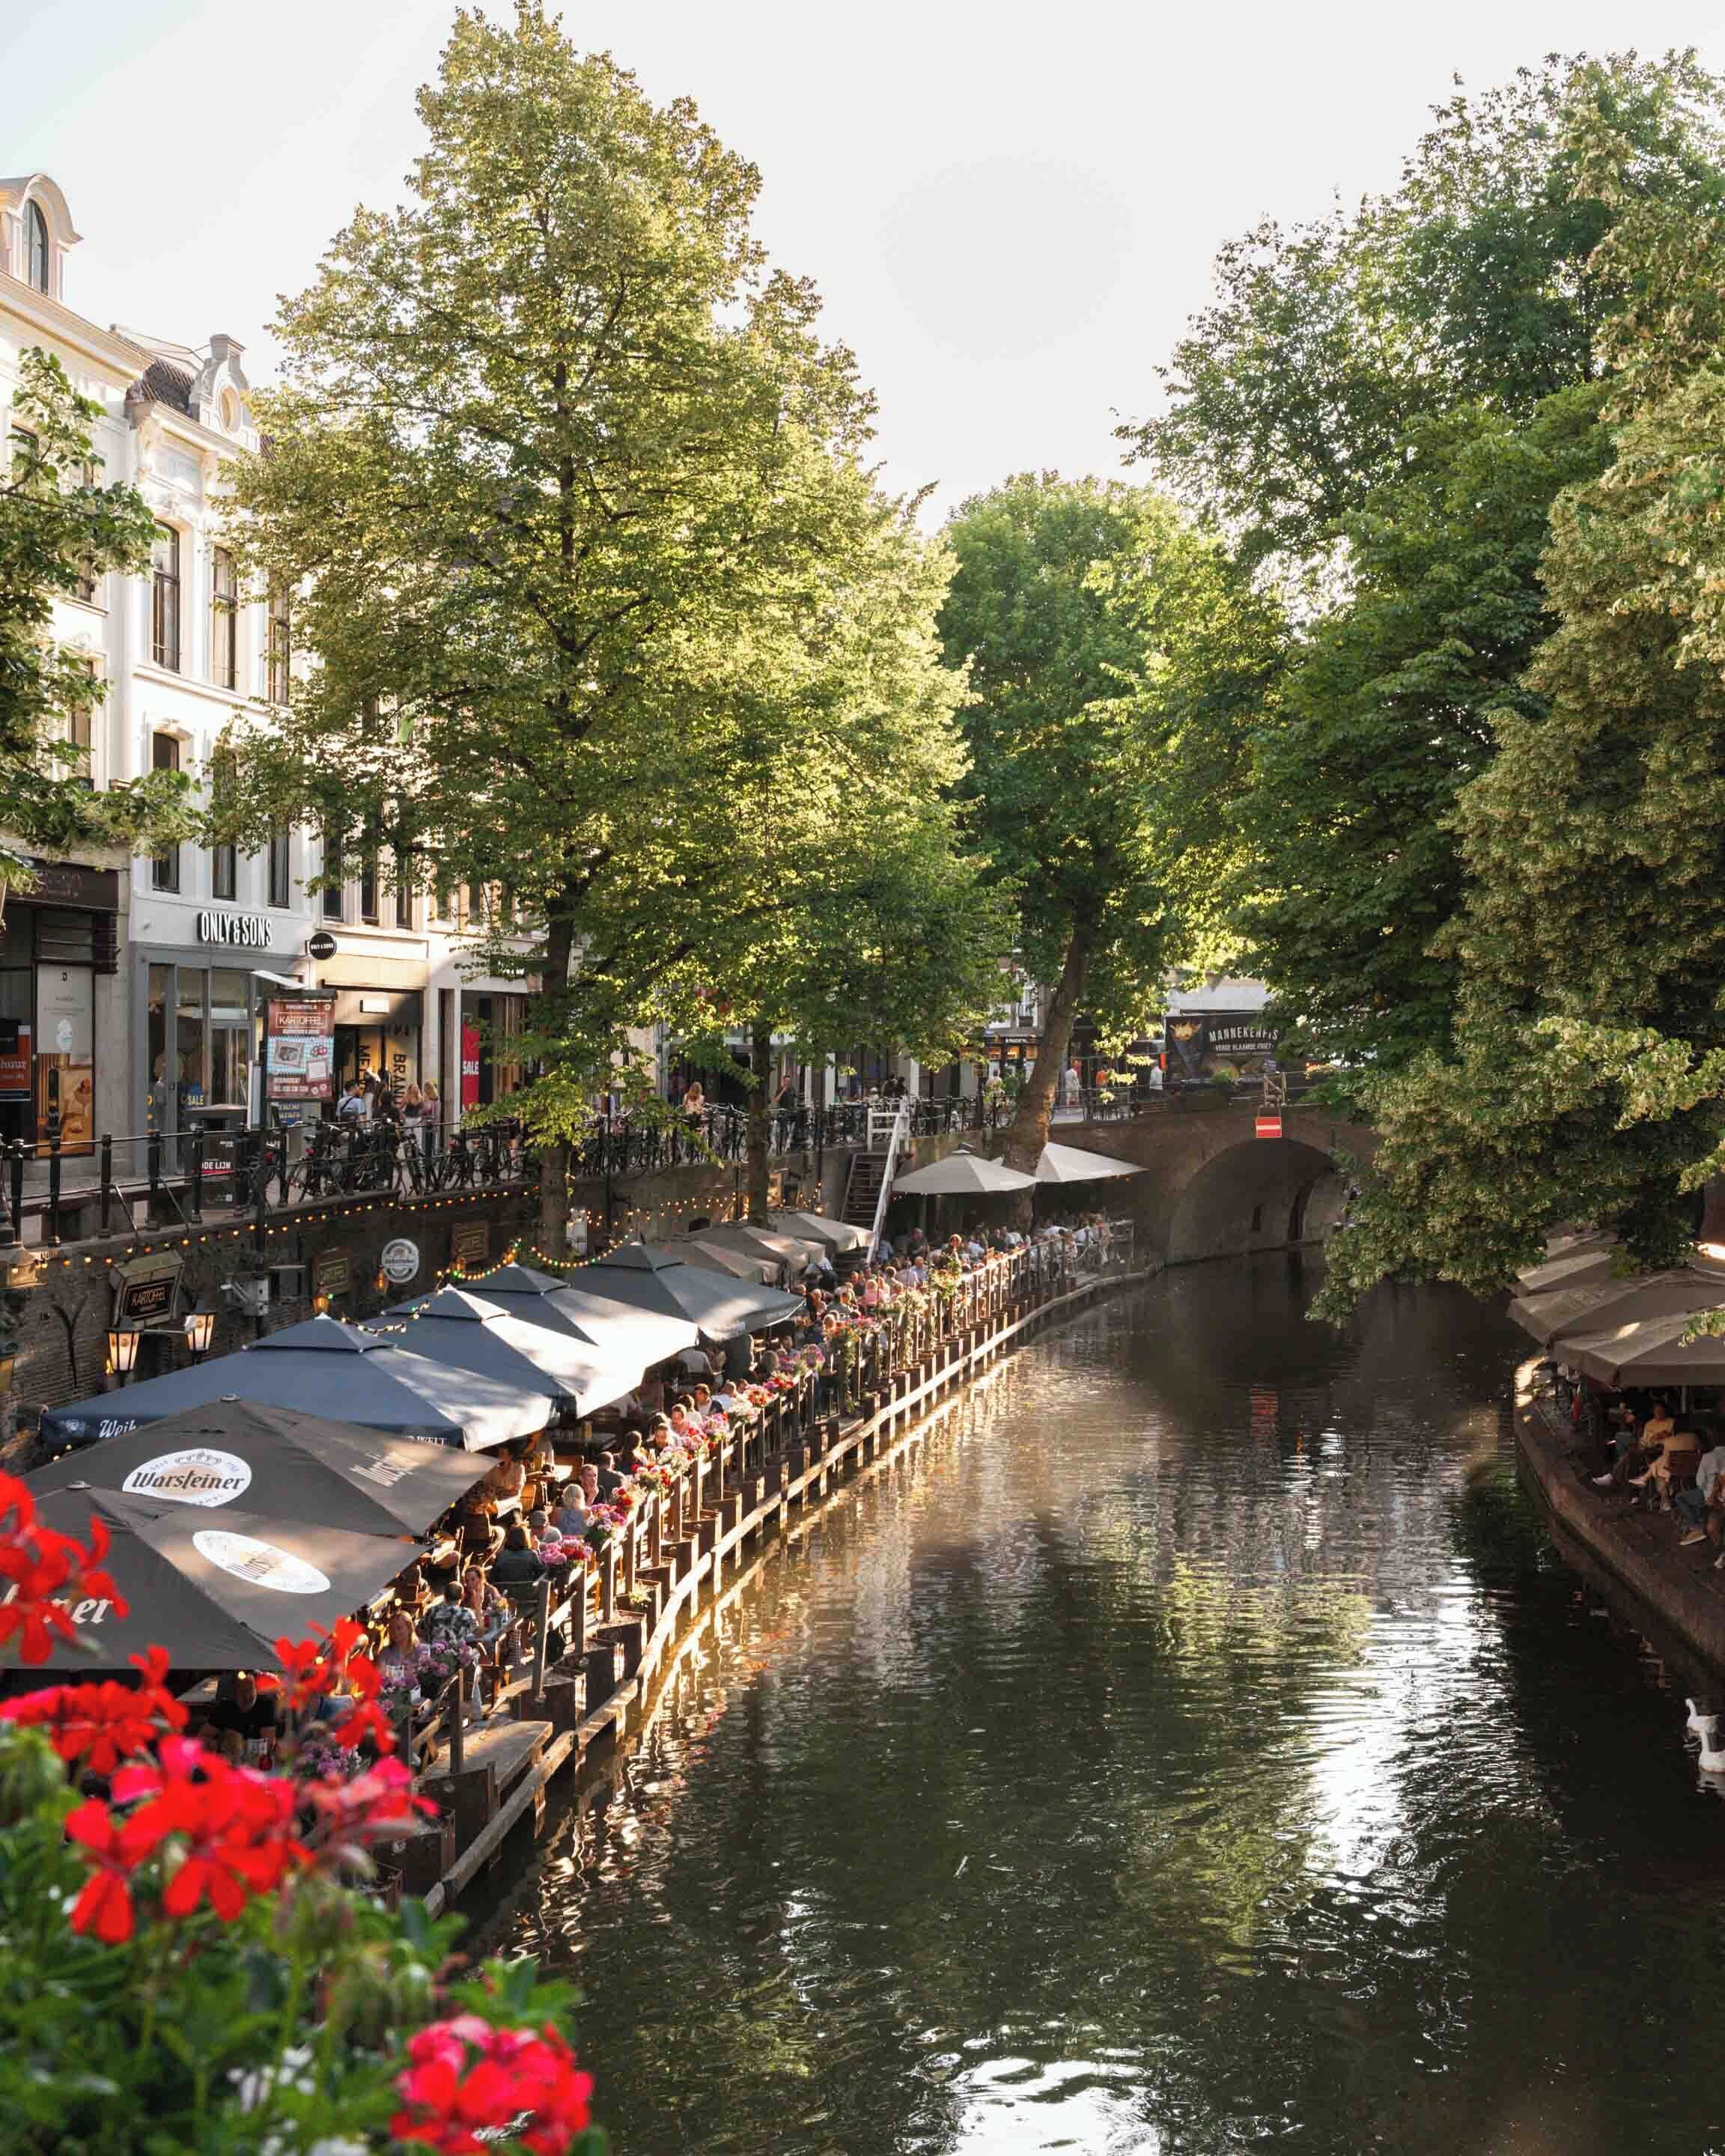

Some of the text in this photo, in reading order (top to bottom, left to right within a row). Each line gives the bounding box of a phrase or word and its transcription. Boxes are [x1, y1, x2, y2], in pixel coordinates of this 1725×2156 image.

[201, 911, 273, 947] ONLY & SONS
[279, 1016, 323, 1025] KARTOFFEL
[462, 1060, 479, 1075] SALE
[187, 1095, 204, 1106] SALE
[215, 1161, 231, 1169] LIJN
[131, 1469, 246, 1490] Warsteiner
